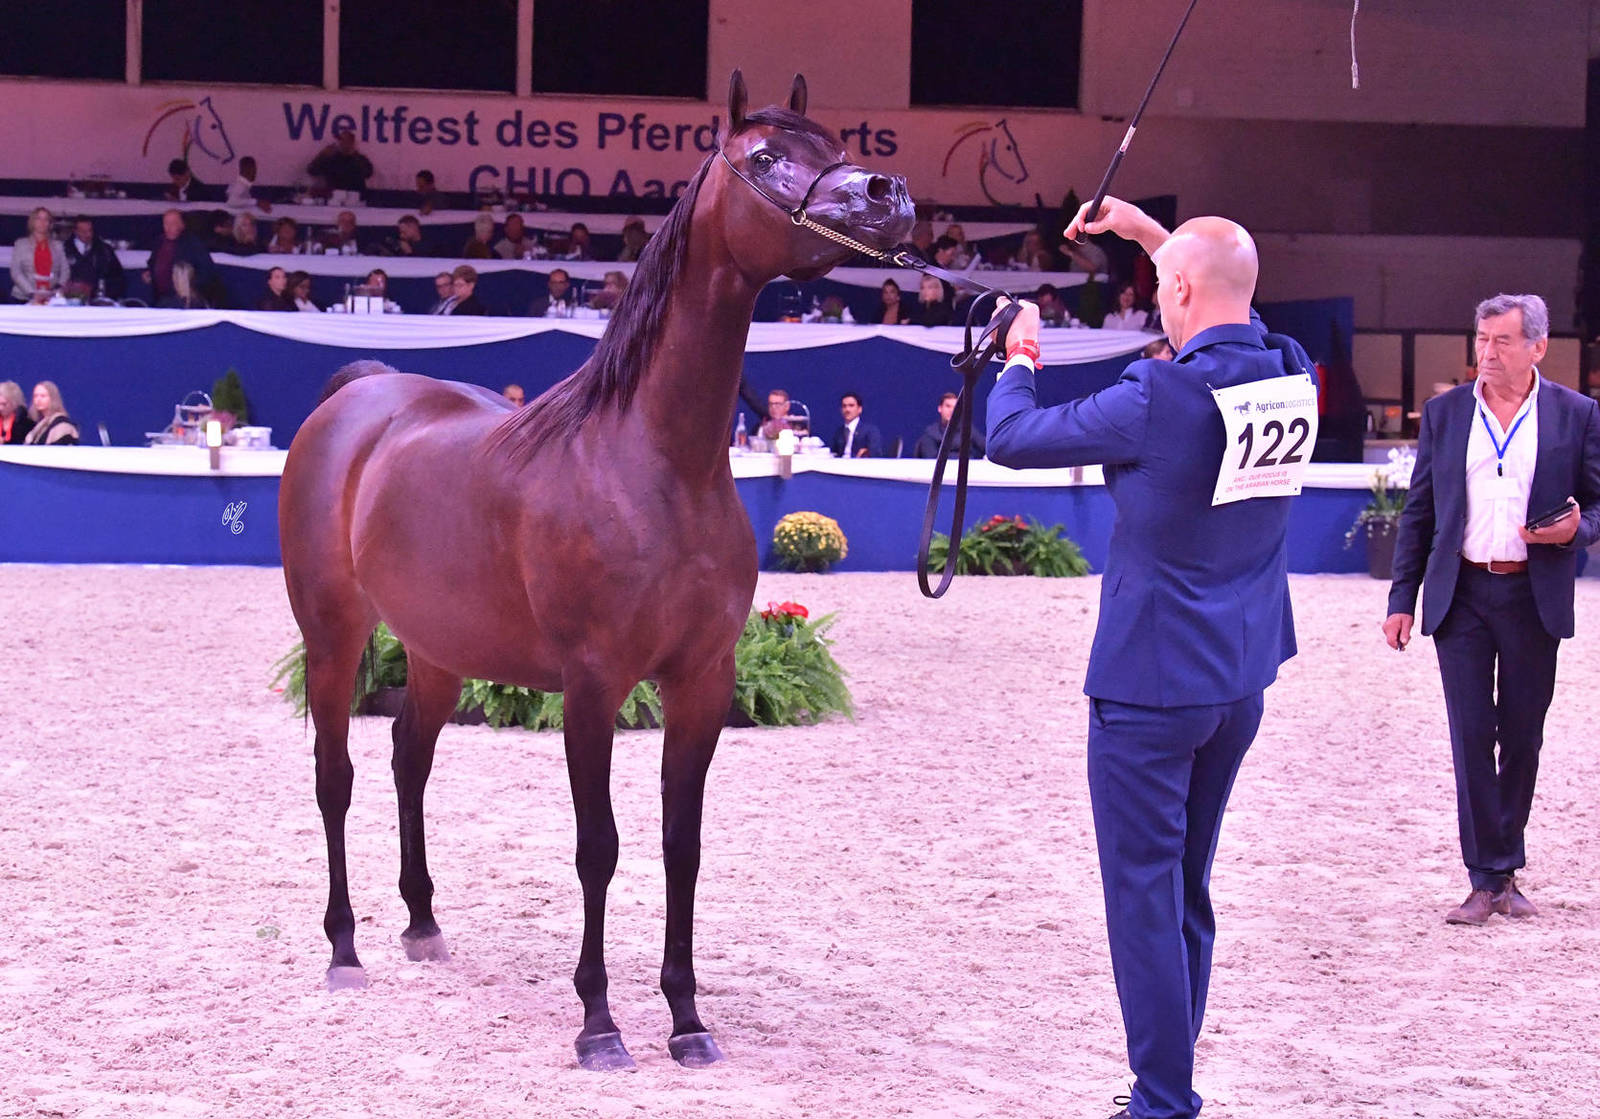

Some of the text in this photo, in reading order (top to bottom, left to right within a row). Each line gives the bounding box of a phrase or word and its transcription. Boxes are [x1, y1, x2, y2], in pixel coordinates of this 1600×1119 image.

[283, 102, 480, 147] Weltfest
[496, 109, 579, 150] des
[468, 164, 591, 196] CHIO
[1238, 417, 1310, 470] 122
